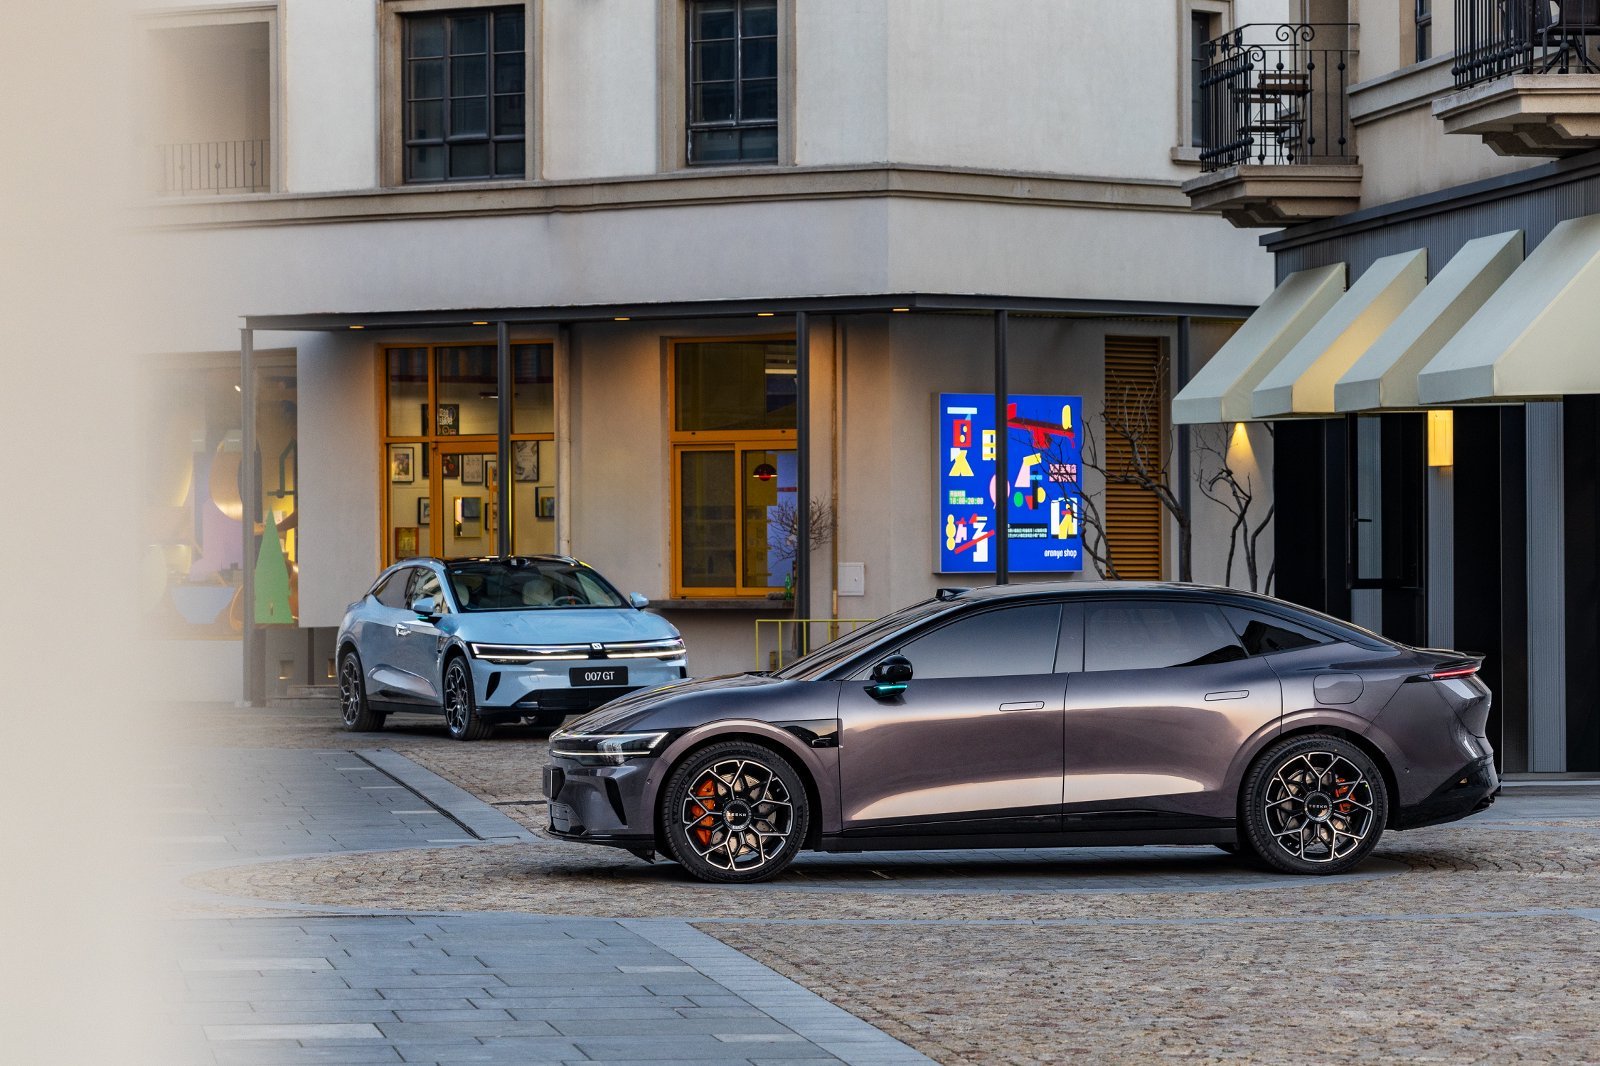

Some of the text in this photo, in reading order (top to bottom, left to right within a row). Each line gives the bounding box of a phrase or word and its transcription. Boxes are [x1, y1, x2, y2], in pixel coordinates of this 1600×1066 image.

[1064, 548, 1077, 559] shop
[585, 671, 615, 681] 007 GT
